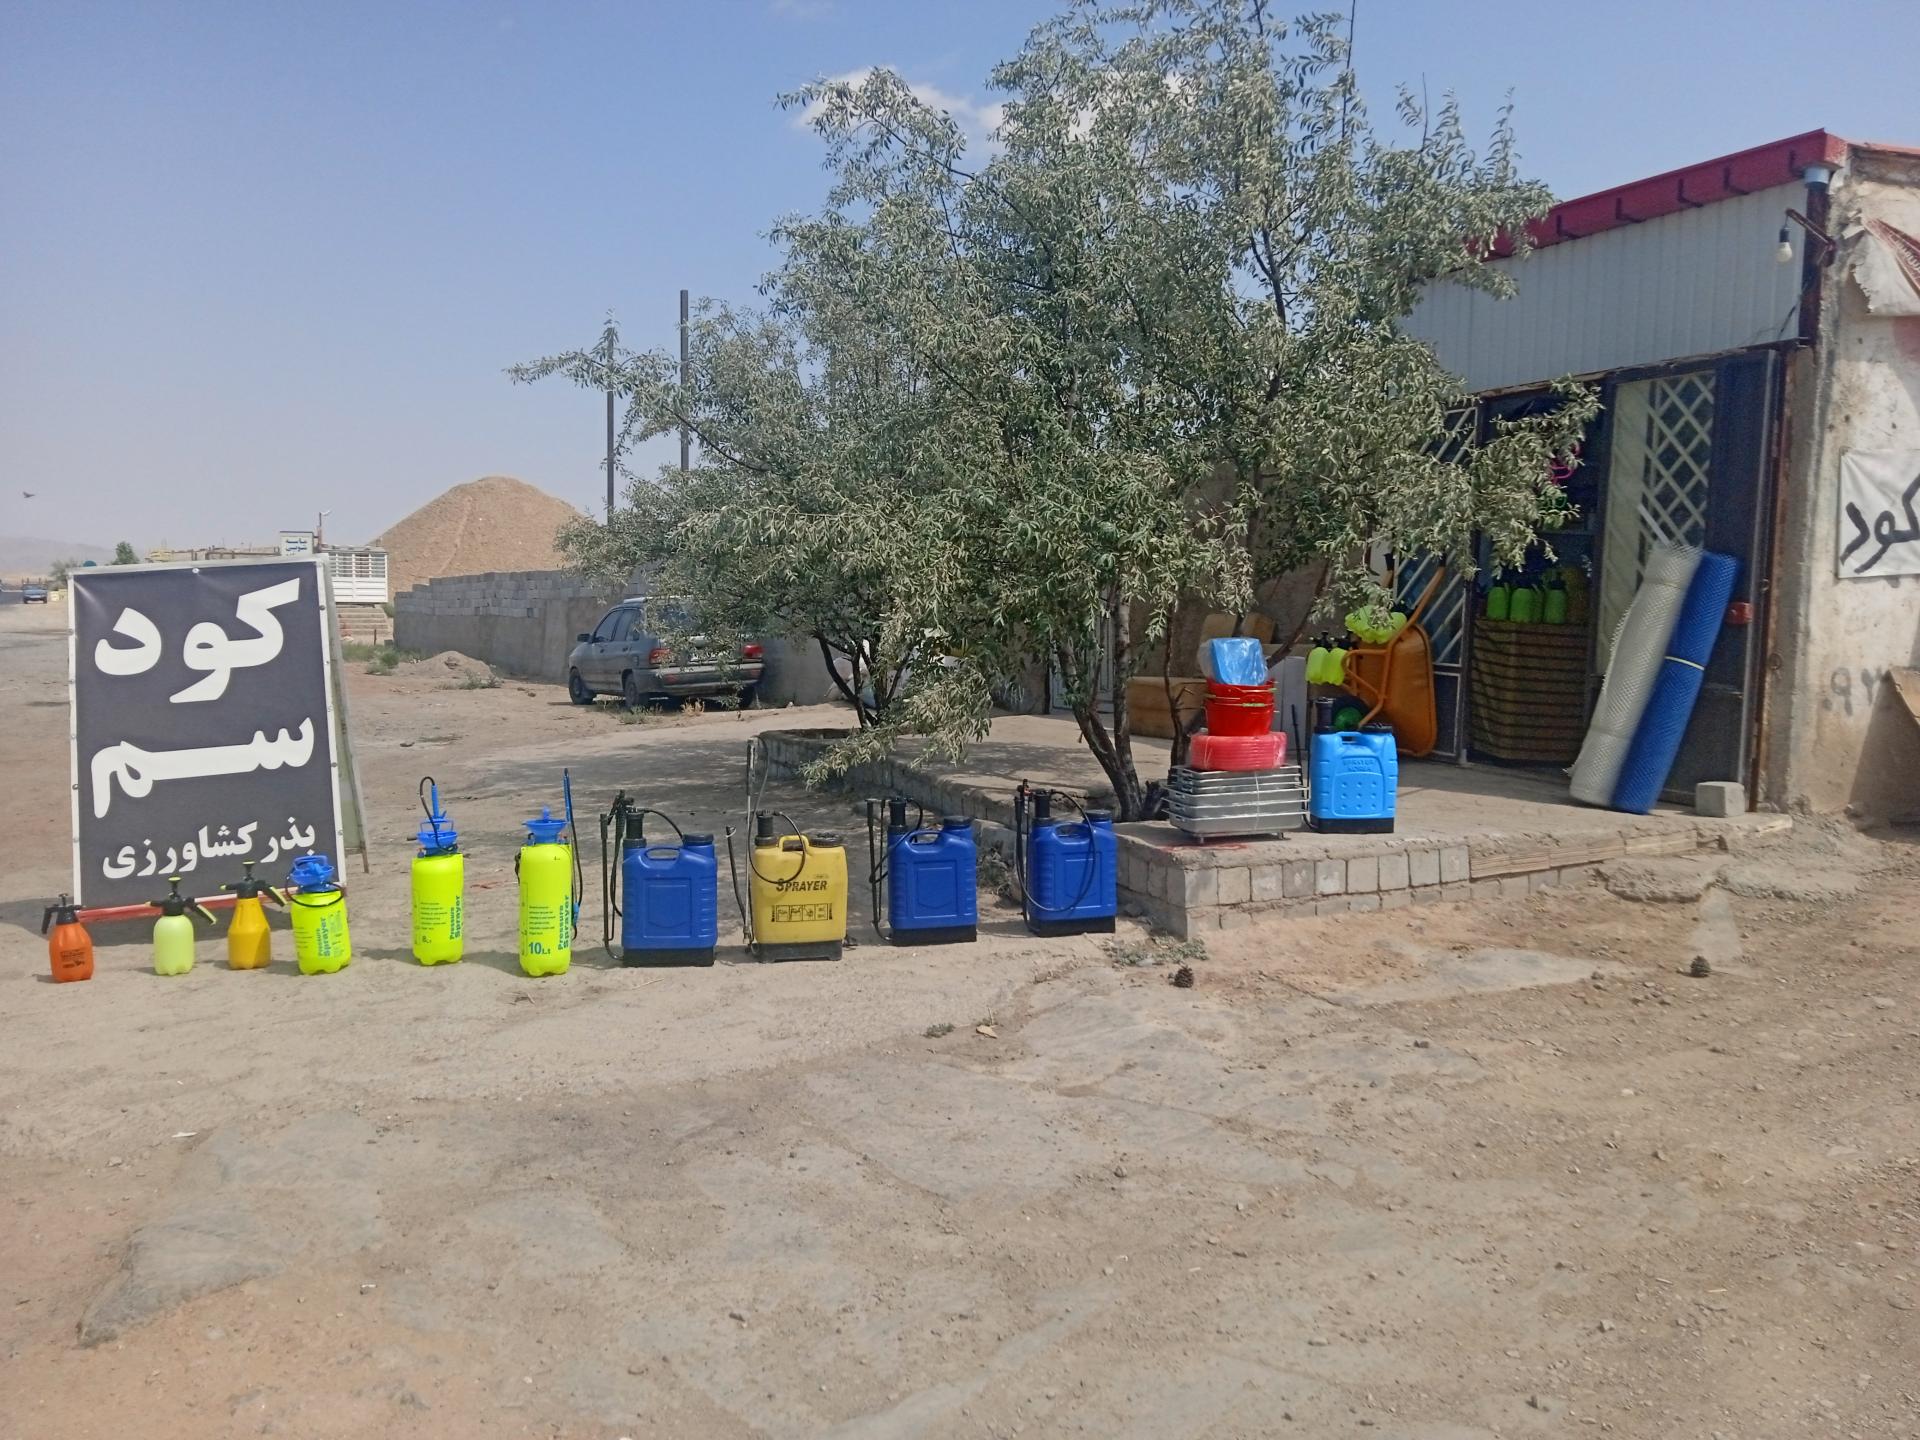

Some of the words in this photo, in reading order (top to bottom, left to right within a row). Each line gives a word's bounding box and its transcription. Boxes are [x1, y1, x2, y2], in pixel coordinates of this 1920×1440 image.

[95, 577, 300, 703] کود
[91, 717, 314, 818] سم
[103, 821, 258, 879] کشاورزی
[261, 816, 316, 863] بذر
[776, 878, 827, 892] SPRAYER
